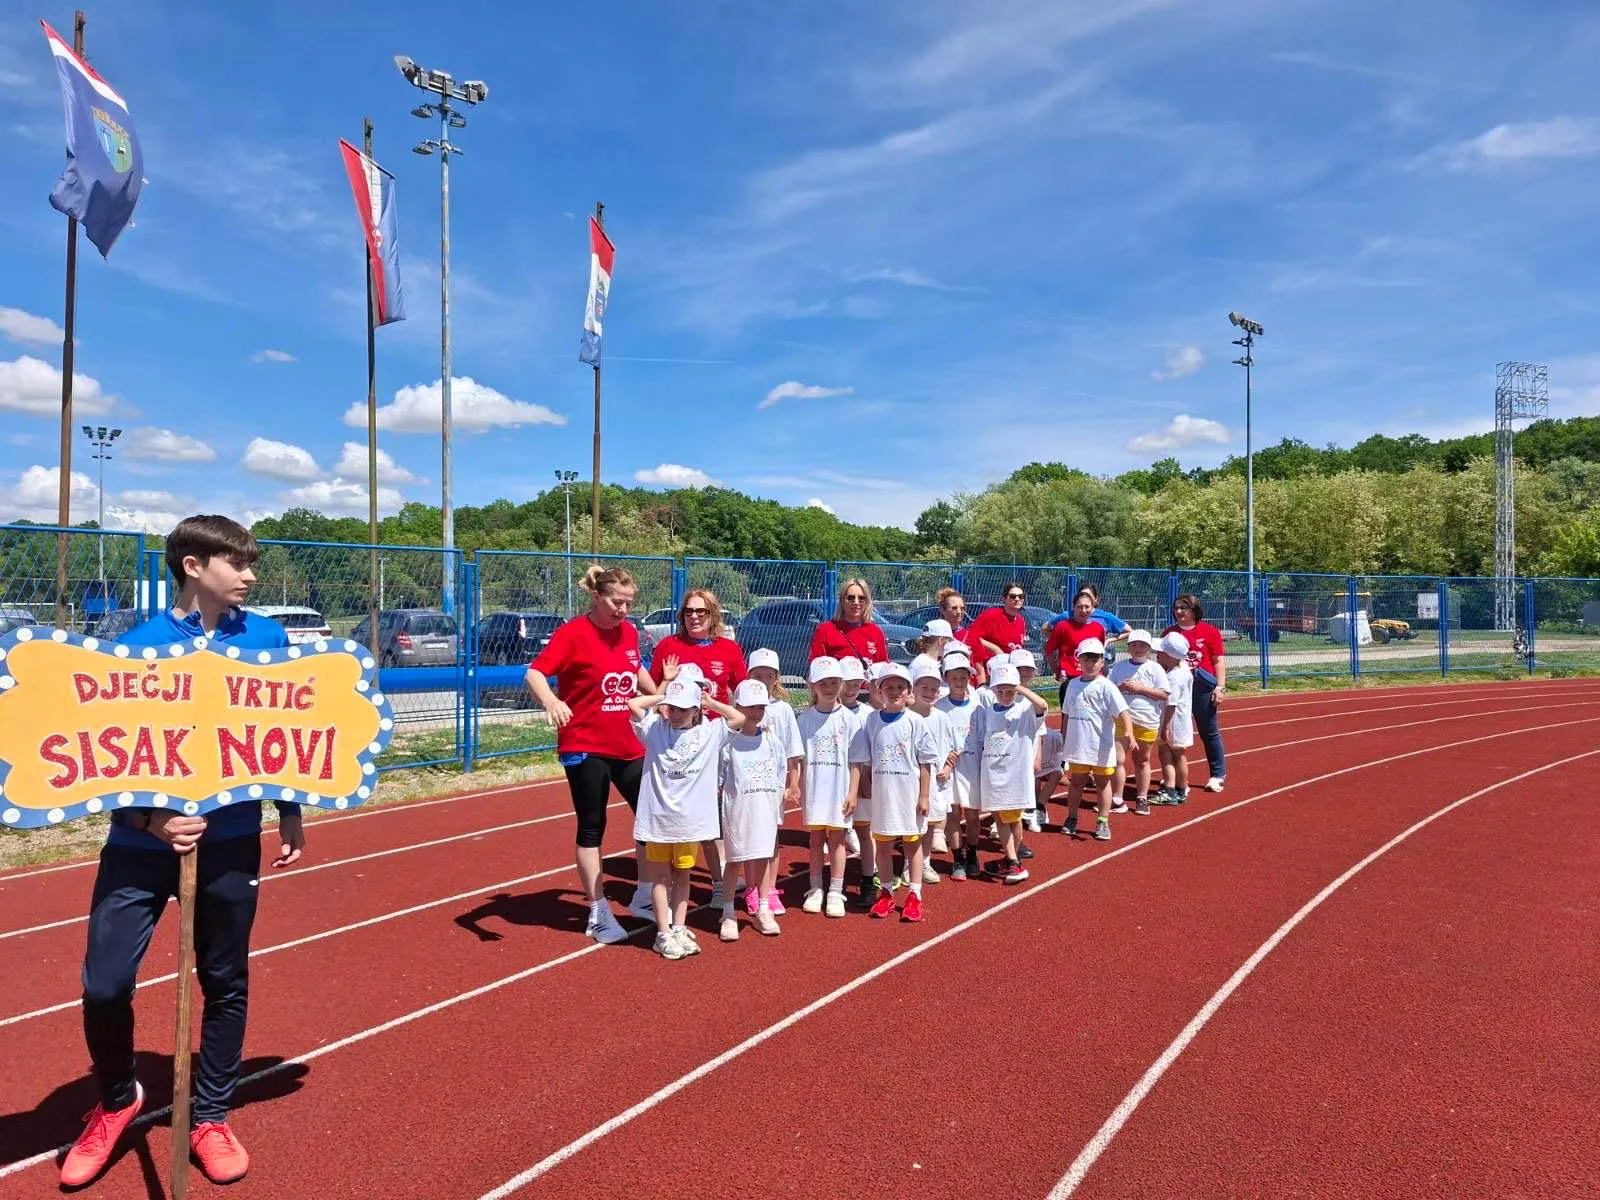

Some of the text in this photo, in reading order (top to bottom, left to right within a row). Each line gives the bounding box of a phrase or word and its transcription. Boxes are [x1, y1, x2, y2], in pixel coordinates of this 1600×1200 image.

[73, 664, 316, 711] DJEČJI VRTIĆ
[40, 724, 336, 788] SISAK NOVI
